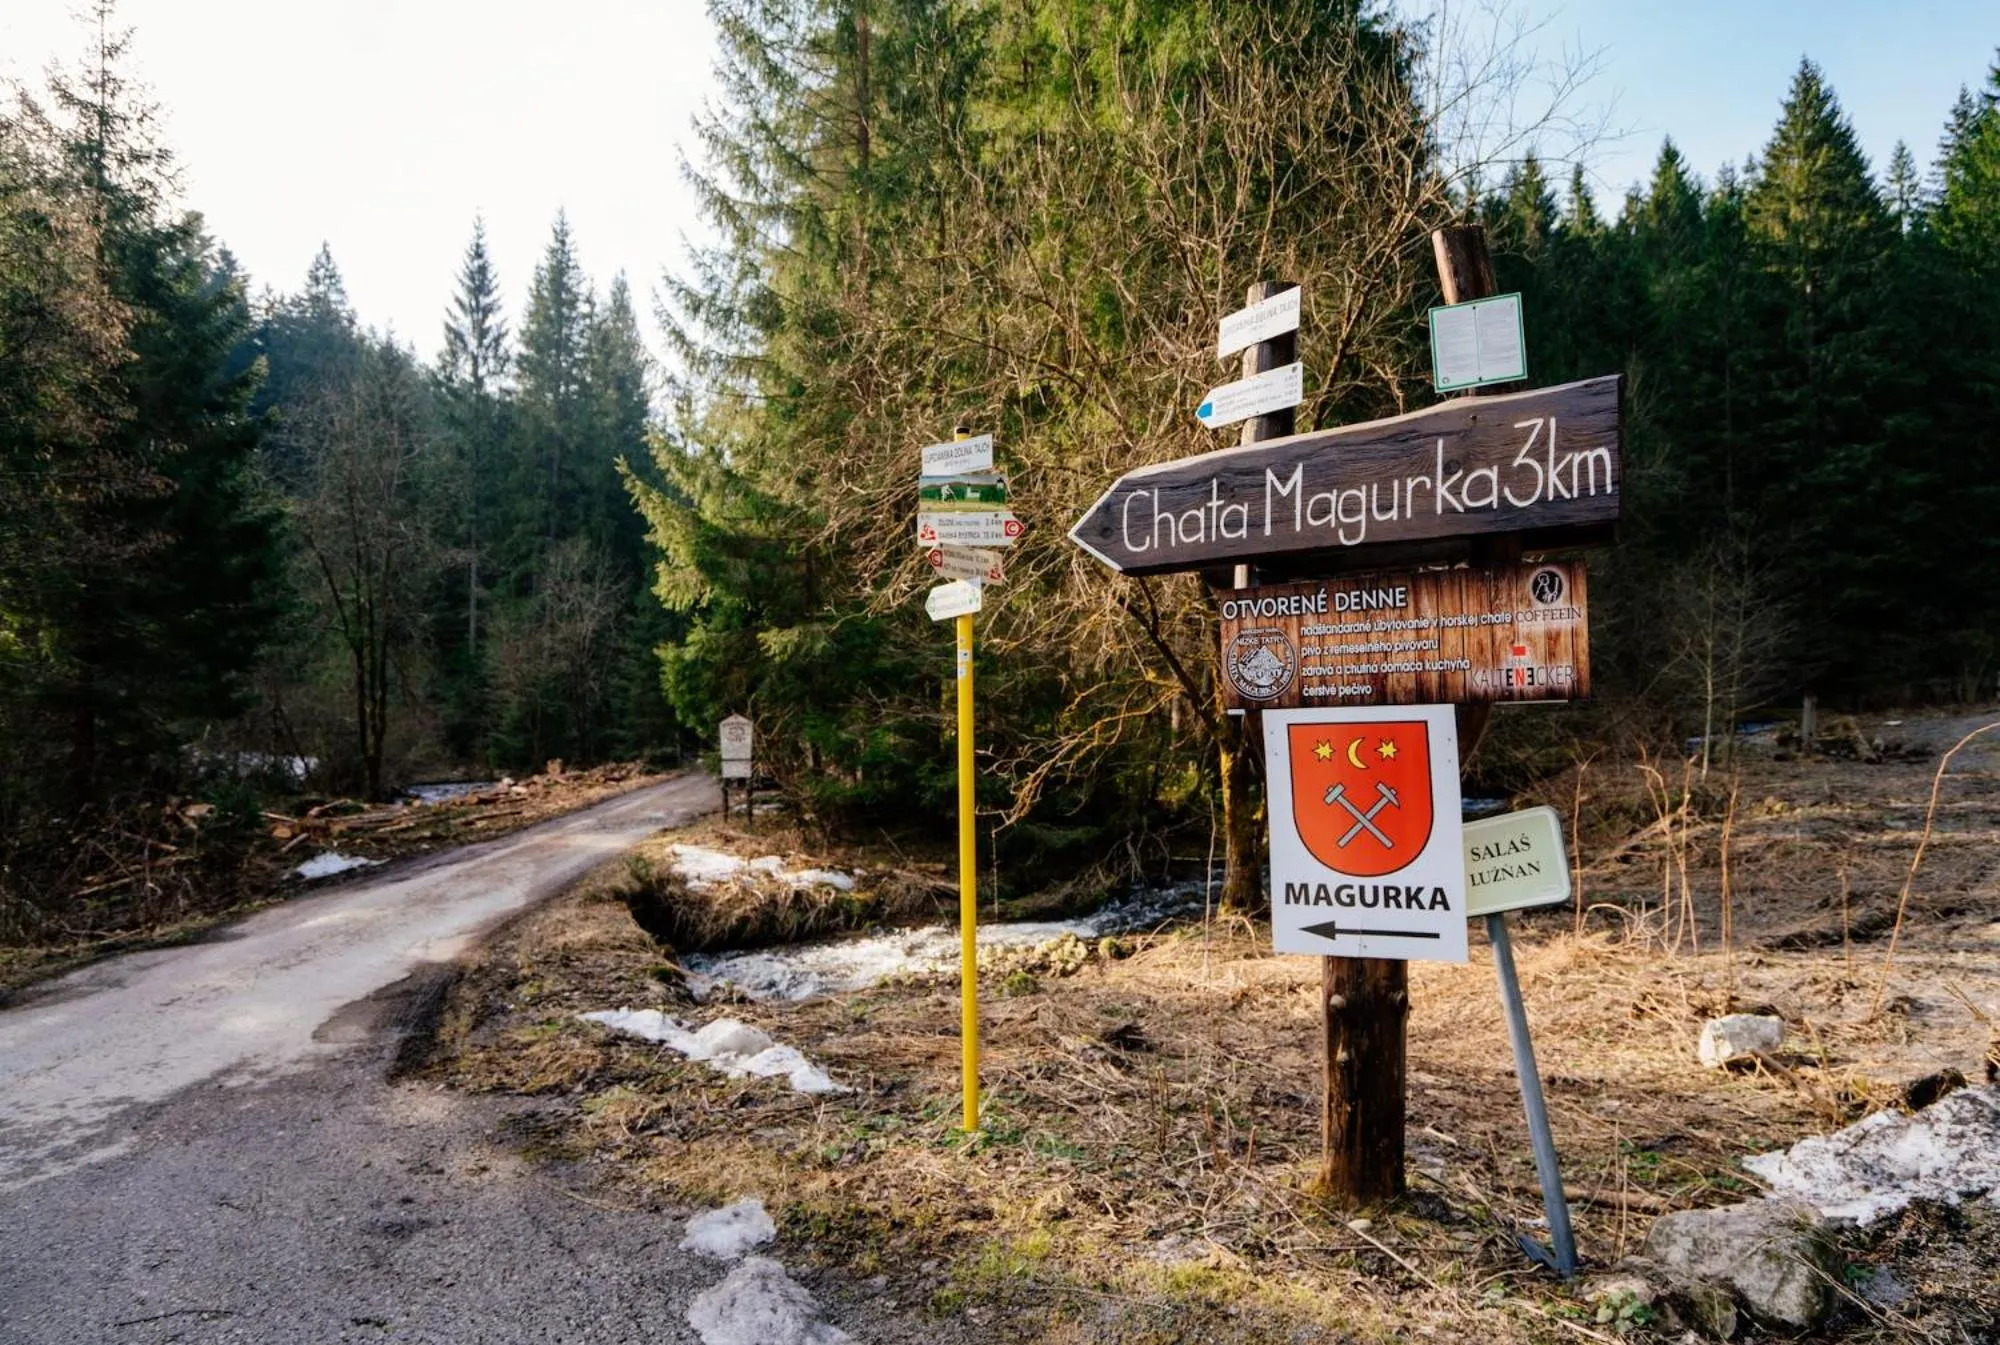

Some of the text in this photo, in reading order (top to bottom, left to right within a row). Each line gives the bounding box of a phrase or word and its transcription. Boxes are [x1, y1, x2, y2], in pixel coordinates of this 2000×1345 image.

[1121, 478, 1248, 553] Chata
[1264, 437, 1499, 546] Magurka
[1223, 587, 1407, 620] OTVORENÉ DENNE
[1515, 607, 1582, 623] COFFEEIN
[1301, 612, 1512, 636] nadštandardné ubytovanie v horskej chate
[1301, 639, 1438, 658] pivo z remeselného pivovaru
[1302, 657, 1470, 676] zdravá a chutná domáca kuchyňa
[1303, 683, 1372, 697] čerstvé pečivo
[1470, 833, 1532, 863] SALAŠ
[1284, 882, 1451, 911] MAGURKA
